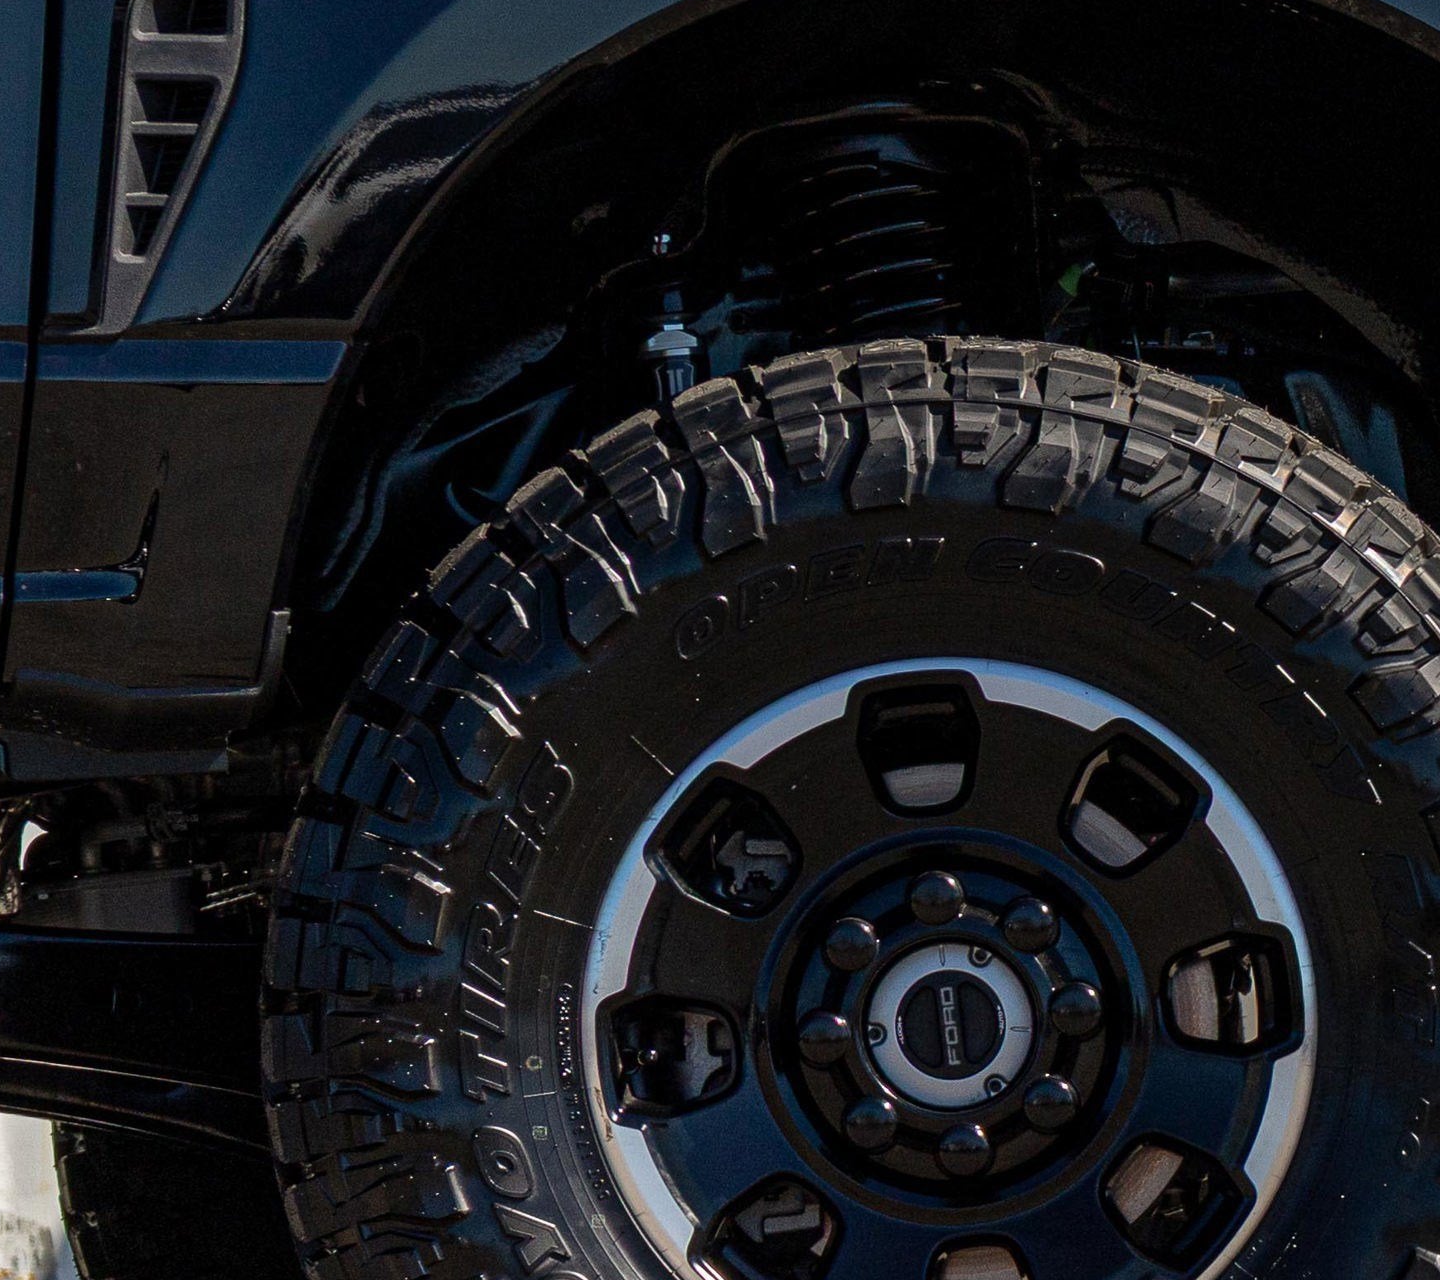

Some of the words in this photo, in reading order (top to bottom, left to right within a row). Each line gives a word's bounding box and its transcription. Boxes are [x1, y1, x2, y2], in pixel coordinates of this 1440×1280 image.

[675, 536, 950, 660] OPEN
[964, 536, 1382, 805] COUNTRY
[458, 739, 575, 1104] TIRES
[940, 986, 961, 1066] FORD
